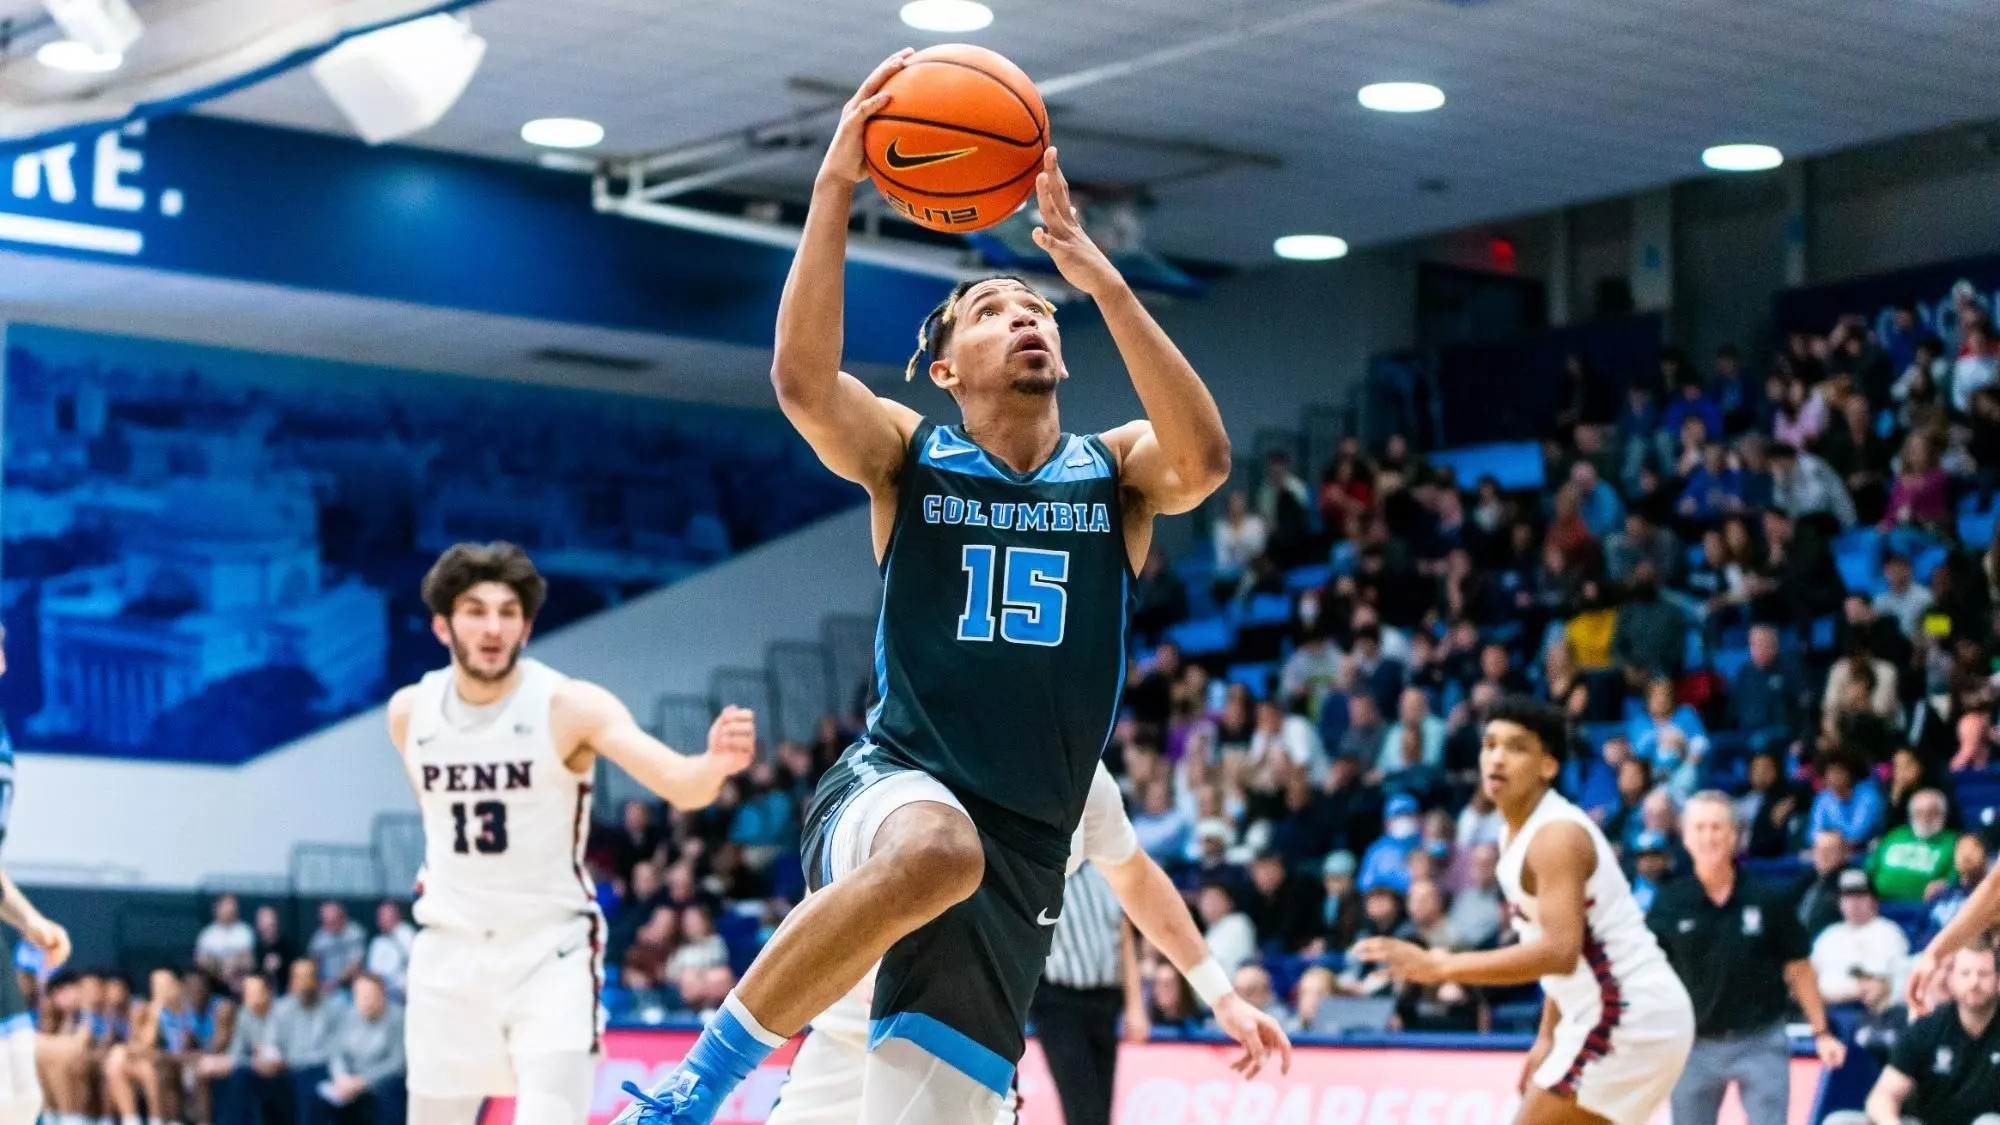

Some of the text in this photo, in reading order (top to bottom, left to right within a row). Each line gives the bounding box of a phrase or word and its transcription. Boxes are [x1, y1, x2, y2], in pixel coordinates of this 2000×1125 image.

[923, 494, 1110, 532] COLUMBIA
[957, 544, 1070, 647] 15
[421, 760, 533, 792] PENN
[451, 799, 509, 855] 13
